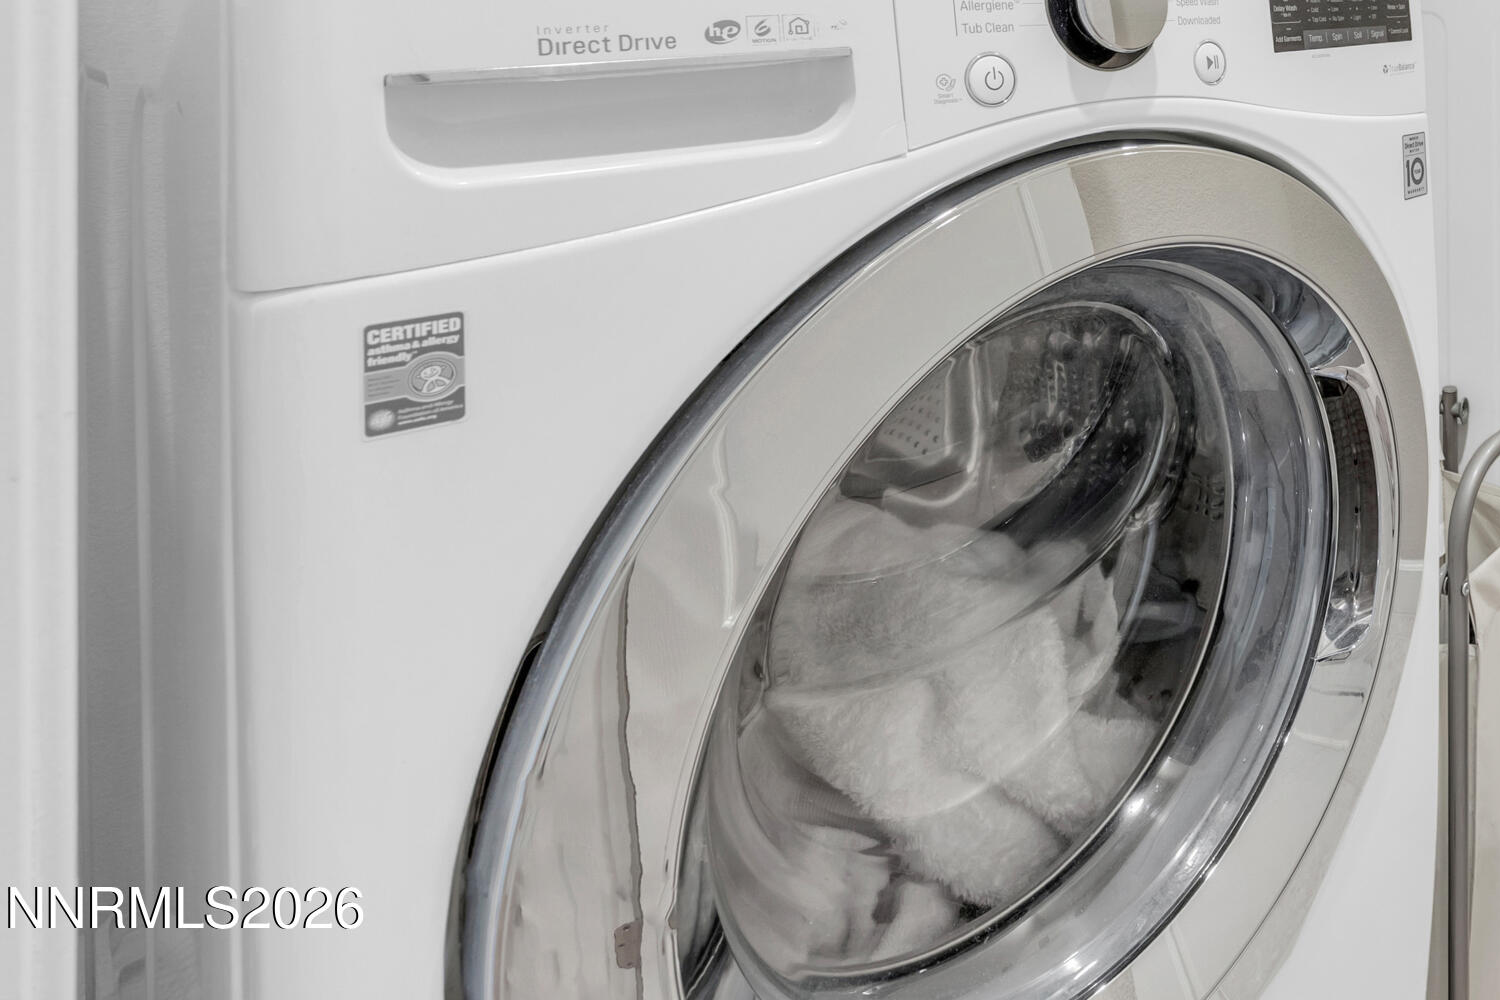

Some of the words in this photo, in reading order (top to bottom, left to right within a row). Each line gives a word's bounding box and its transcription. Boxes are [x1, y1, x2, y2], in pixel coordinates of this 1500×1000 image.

[536, 24, 609, 36] Inverter
[961, 23, 983, 34] Tub
[985, 22, 1016, 33] Clean
[1177, 15, 1221, 26] Downloaded
[538, 36, 612, 57] Direct
[618, 33, 677, 53] Drive
[1405, 157, 1425, 187] 10
[366, 316, 461, 346] CERTIFIED
[367, 342, 412, 357] asthma
[420, 334, 460, 348] allergy
